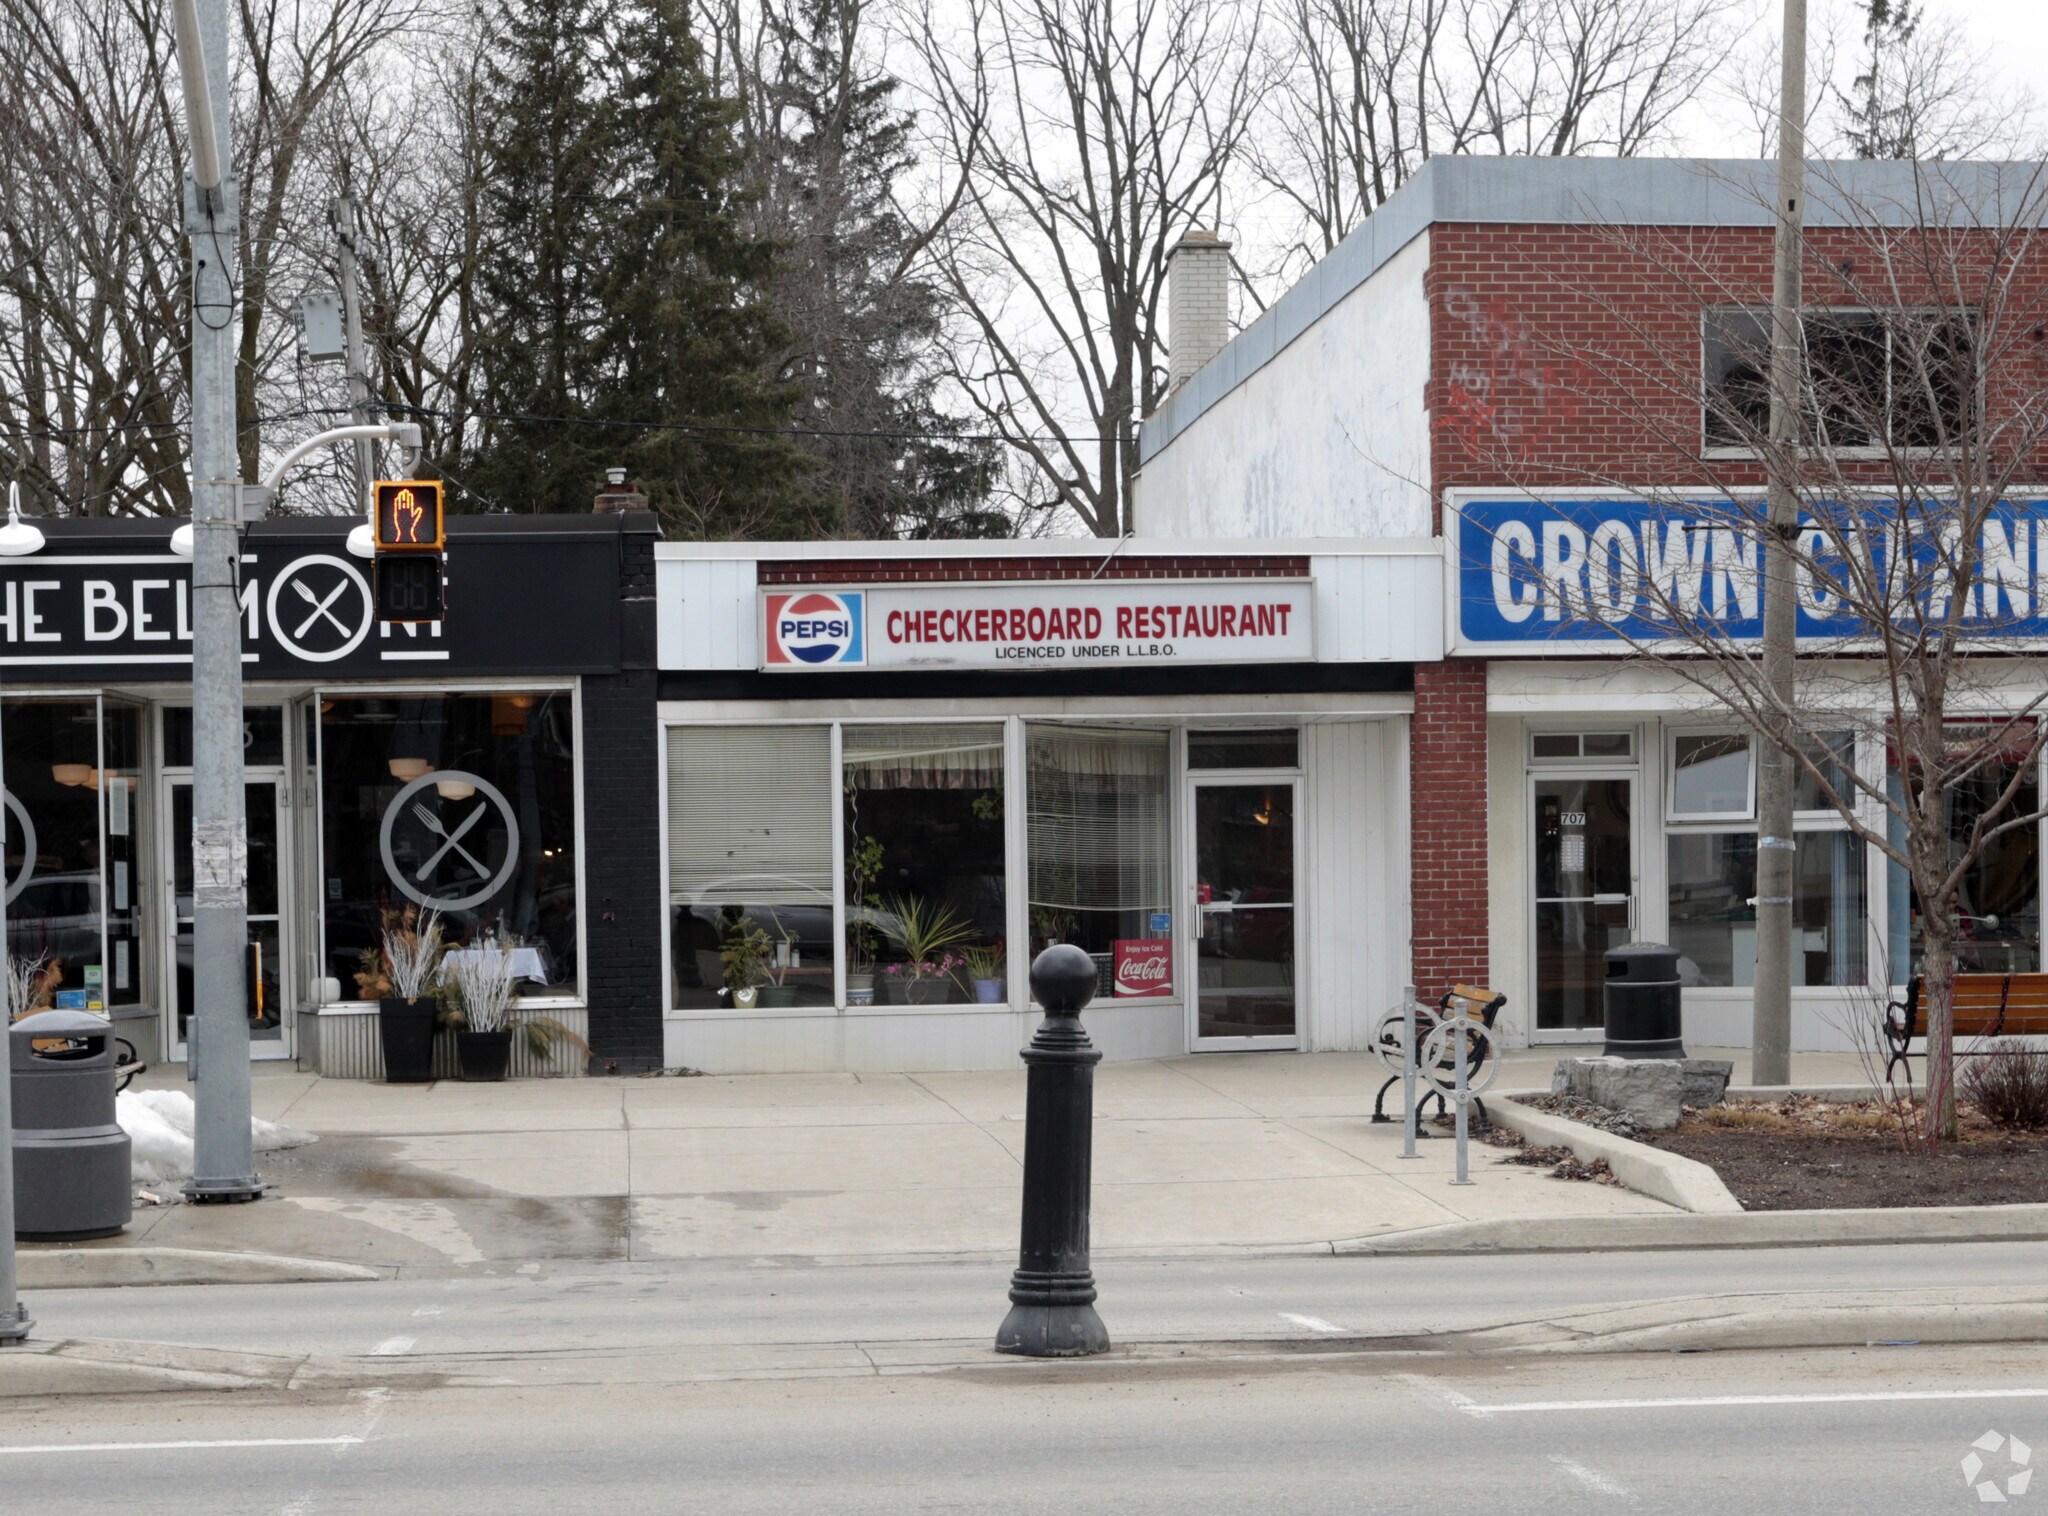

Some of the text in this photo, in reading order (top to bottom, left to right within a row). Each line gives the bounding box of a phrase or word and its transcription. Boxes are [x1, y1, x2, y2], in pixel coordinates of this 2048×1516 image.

[1491, 518, 1759, 624] CROWN
[780, 620, 849, 639] PEPSI
[886, 603, 1292, 645] CHECKERBOARD RESTAURANT
[995, 643, 1177, 659] LICENCED UNDER L.L.B.O.
[1560, 812, 1585, 824] 707
[1125, 945, 1141, 954] Enjoy
[1150, 943, 1164, 952] Cold
[1118, 956, 1169, 981] Coca-Cola
